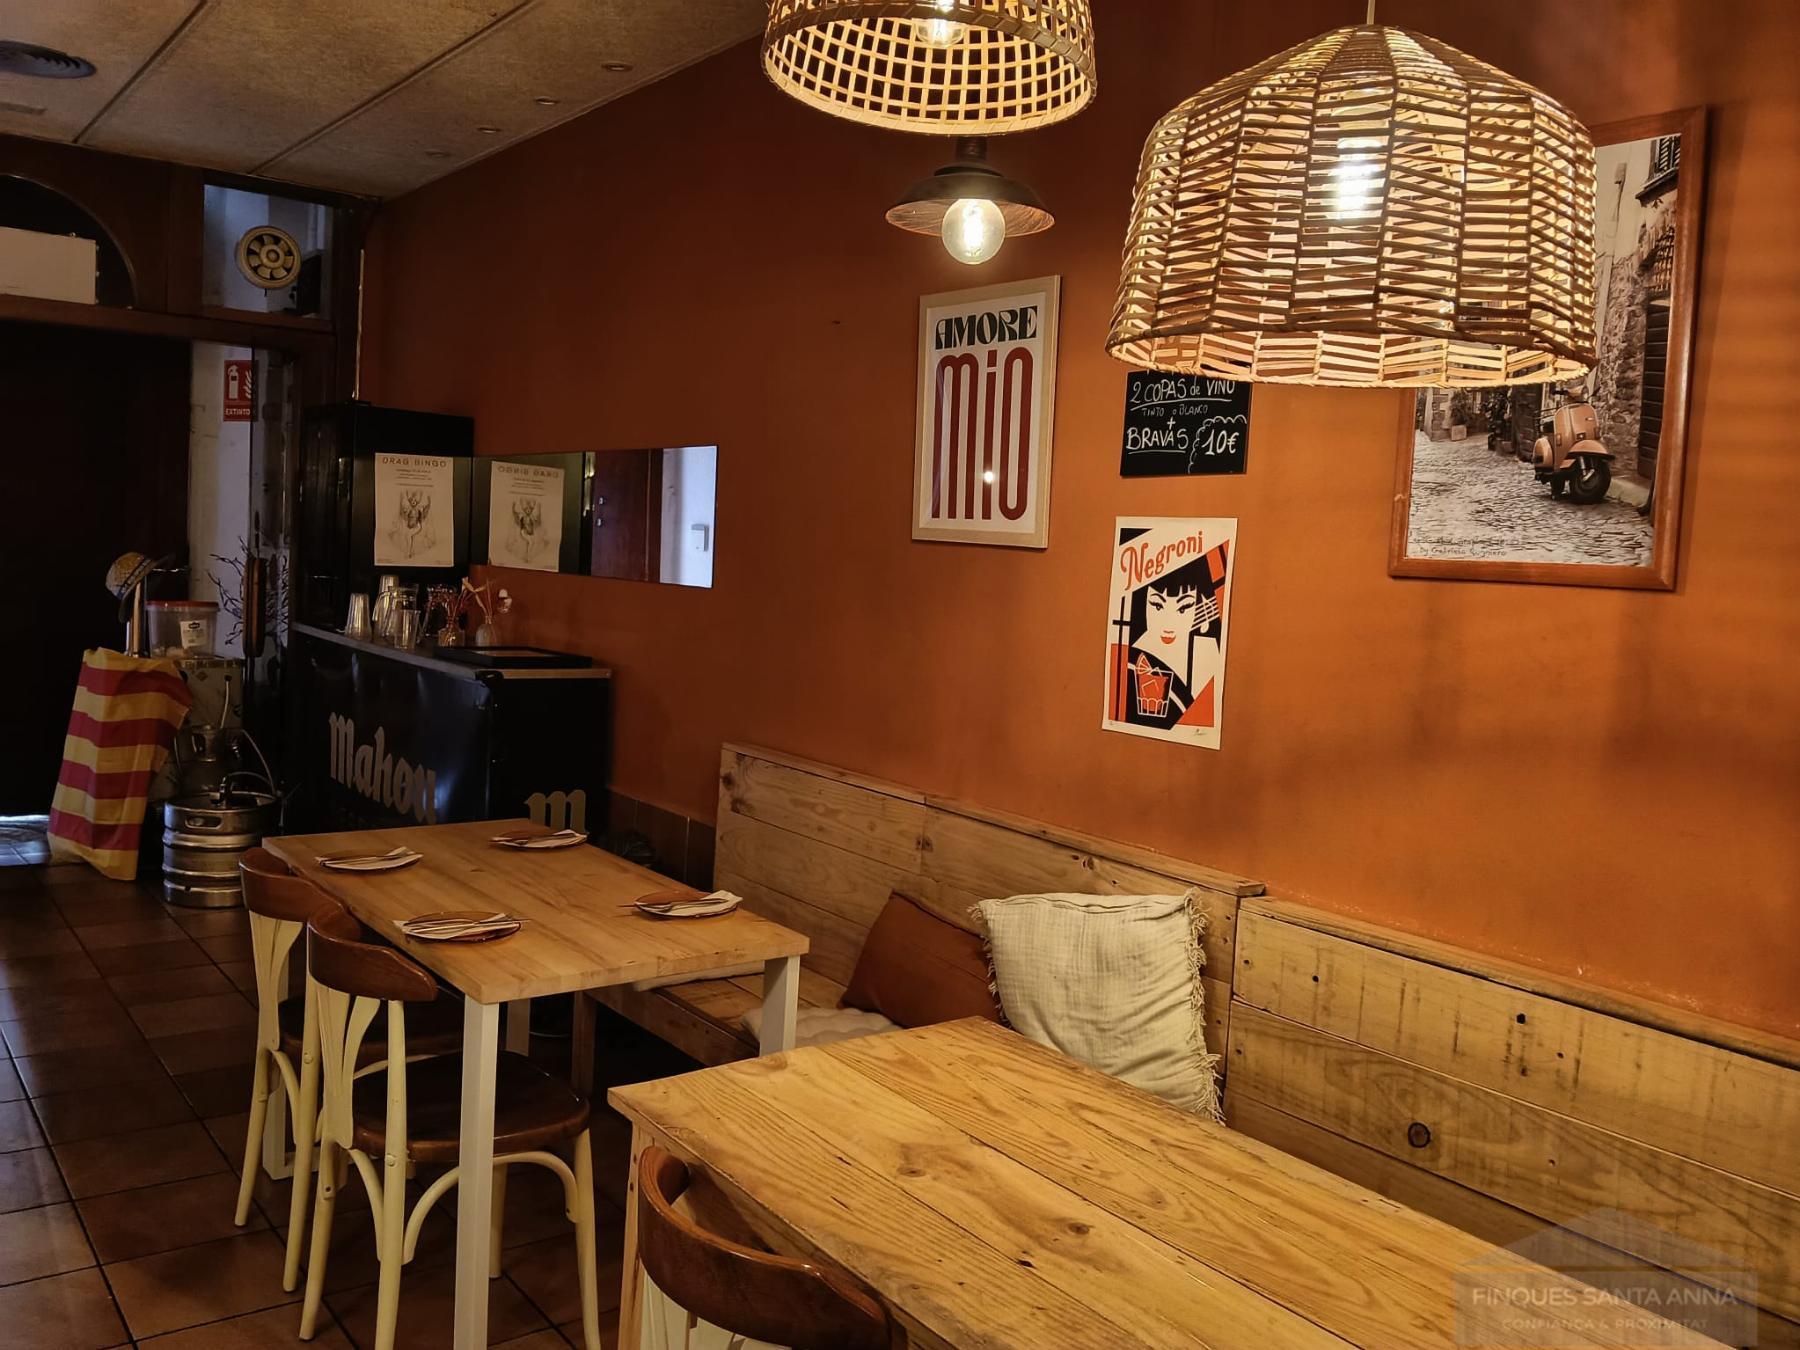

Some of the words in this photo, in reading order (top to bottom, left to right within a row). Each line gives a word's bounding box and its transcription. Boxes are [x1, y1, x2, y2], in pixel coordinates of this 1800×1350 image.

[935, 305, 1038, 350] AMORE
[1129, 381, 1141, 403] 2
[1144, 378, 1187, 402] COPAS
[1190, 375, 1201, 396] de
[225, 408, 256, 416] EXTINTO
[1141, 407, 1165, 417] TINTO
[1179, 404, 1208, 416] BLANCO
[1126, 427, 1189, 450] BRAVAS
[1201, 429, 1240, 455] 10€
[382, 456, 409, 466] DRAG
[414, 459, 447, 468] BINGO
[1120, 531, 1203, 591] Negroni
